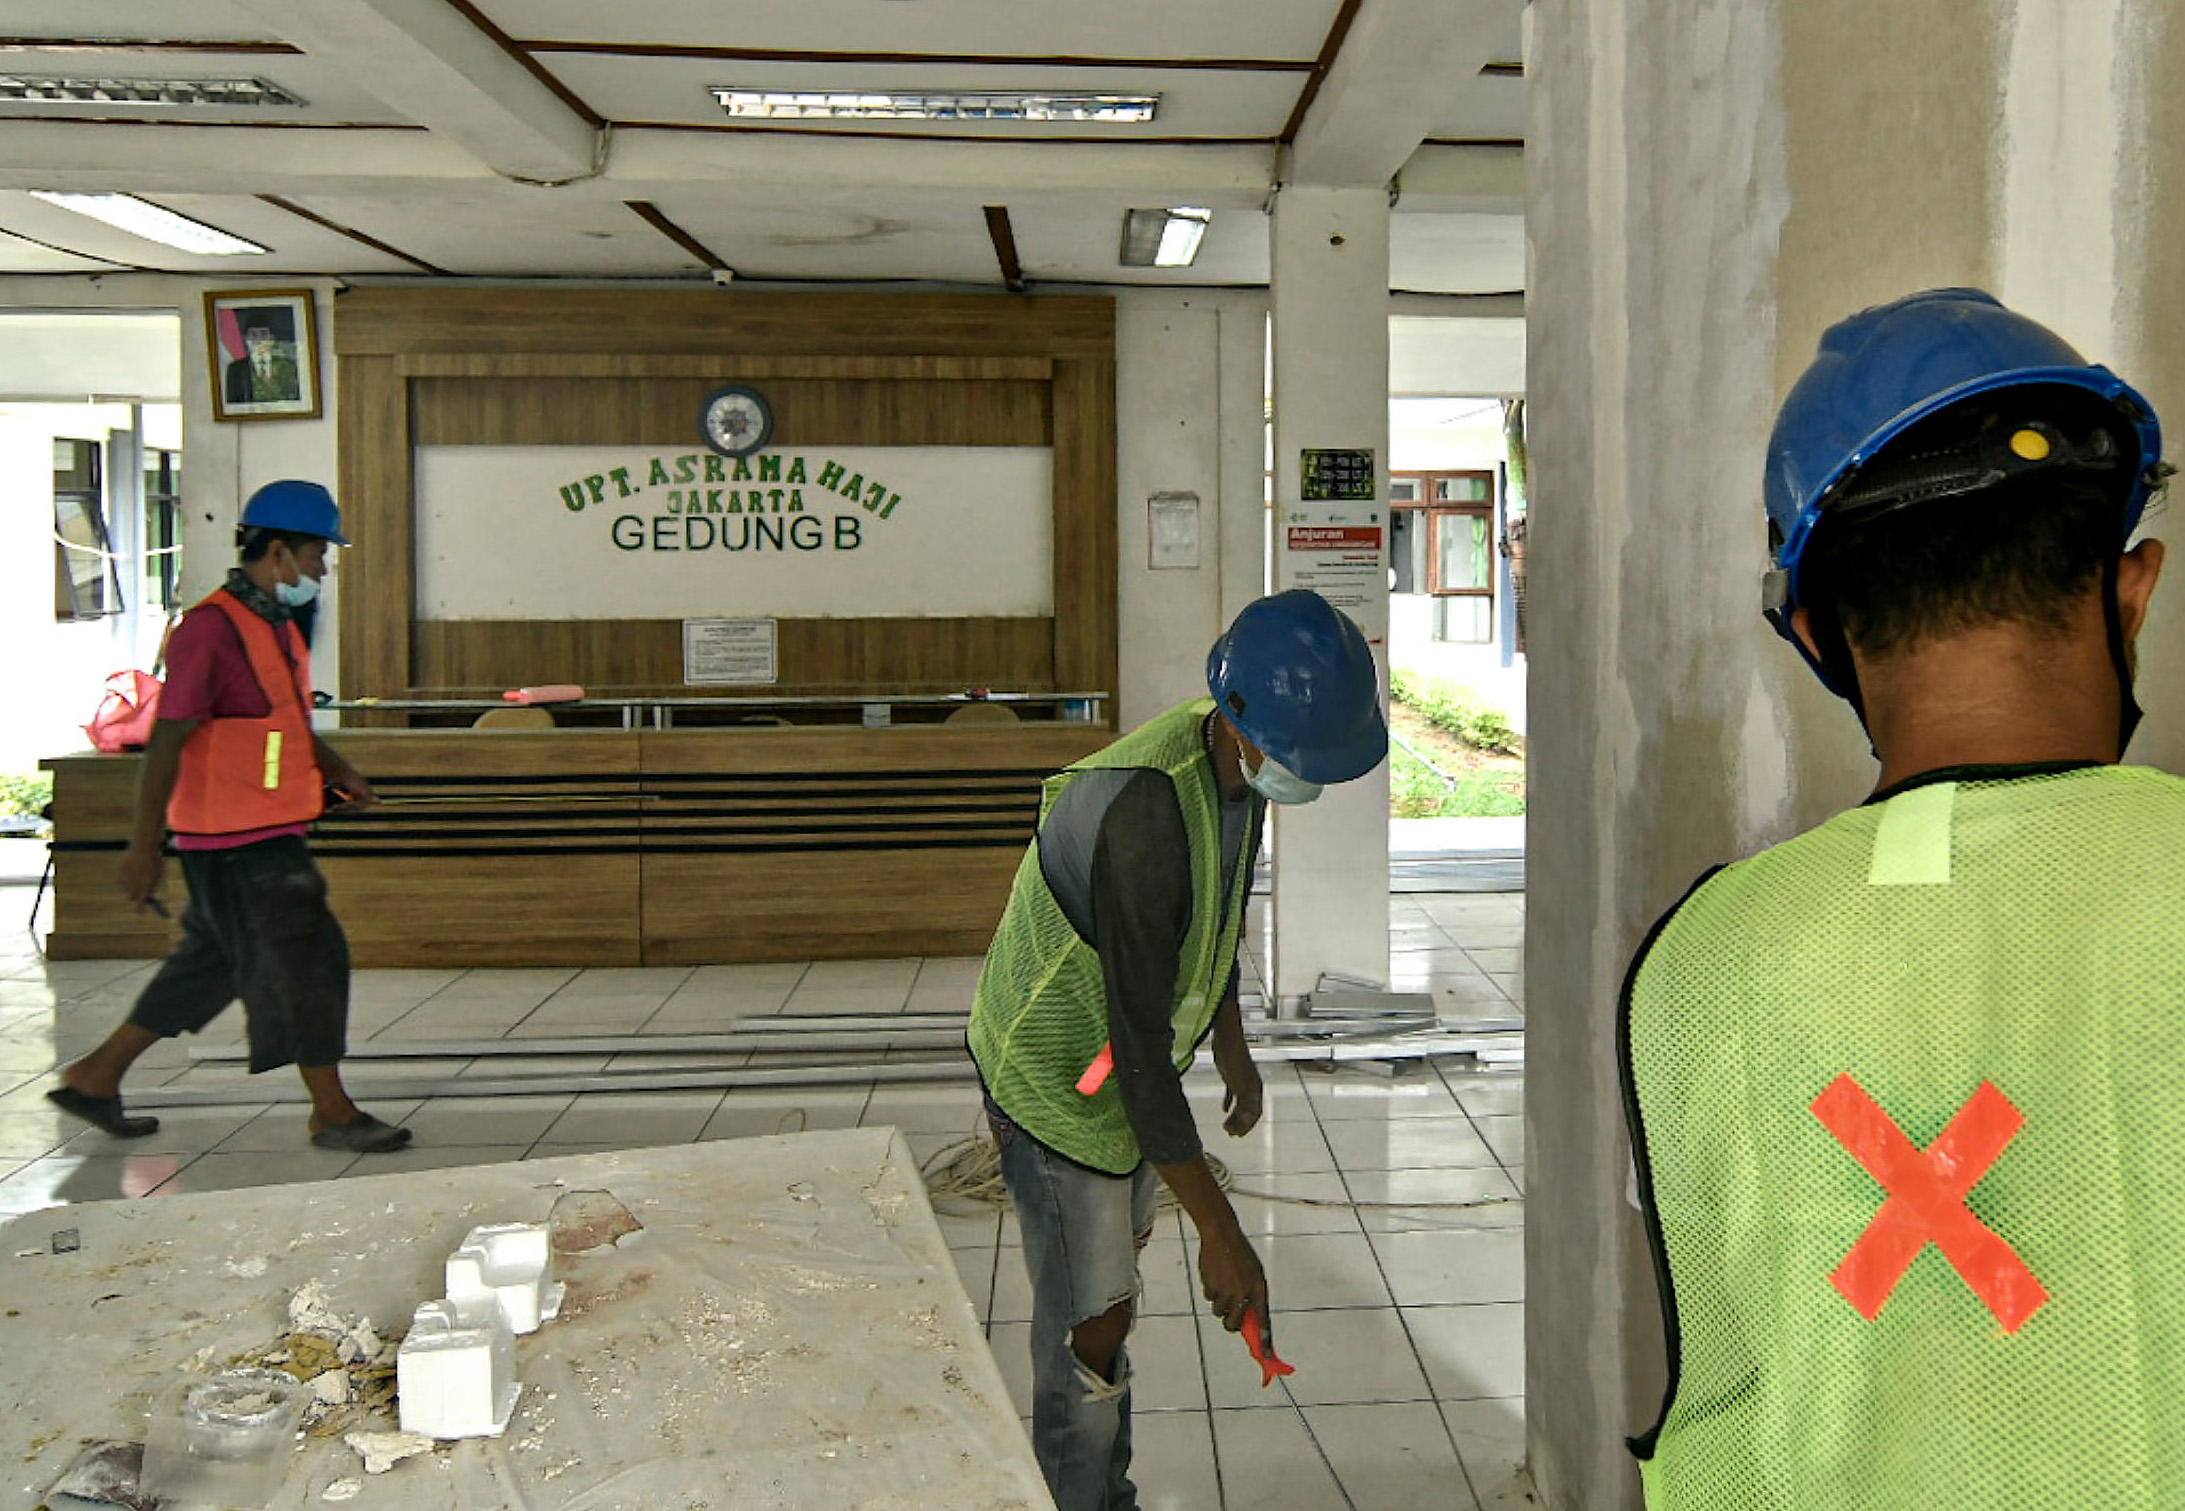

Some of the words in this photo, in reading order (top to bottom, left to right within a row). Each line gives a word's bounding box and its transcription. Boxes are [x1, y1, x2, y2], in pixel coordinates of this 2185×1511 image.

[559, 467, 641, 512] UPT.
[649, 455, 807, 486] ASRAMA
[817, 460, 902, 520] HAJI
[667, 489, 804, 513] JAKARTA
[1290, 527, 1344, 541] Anjuran
